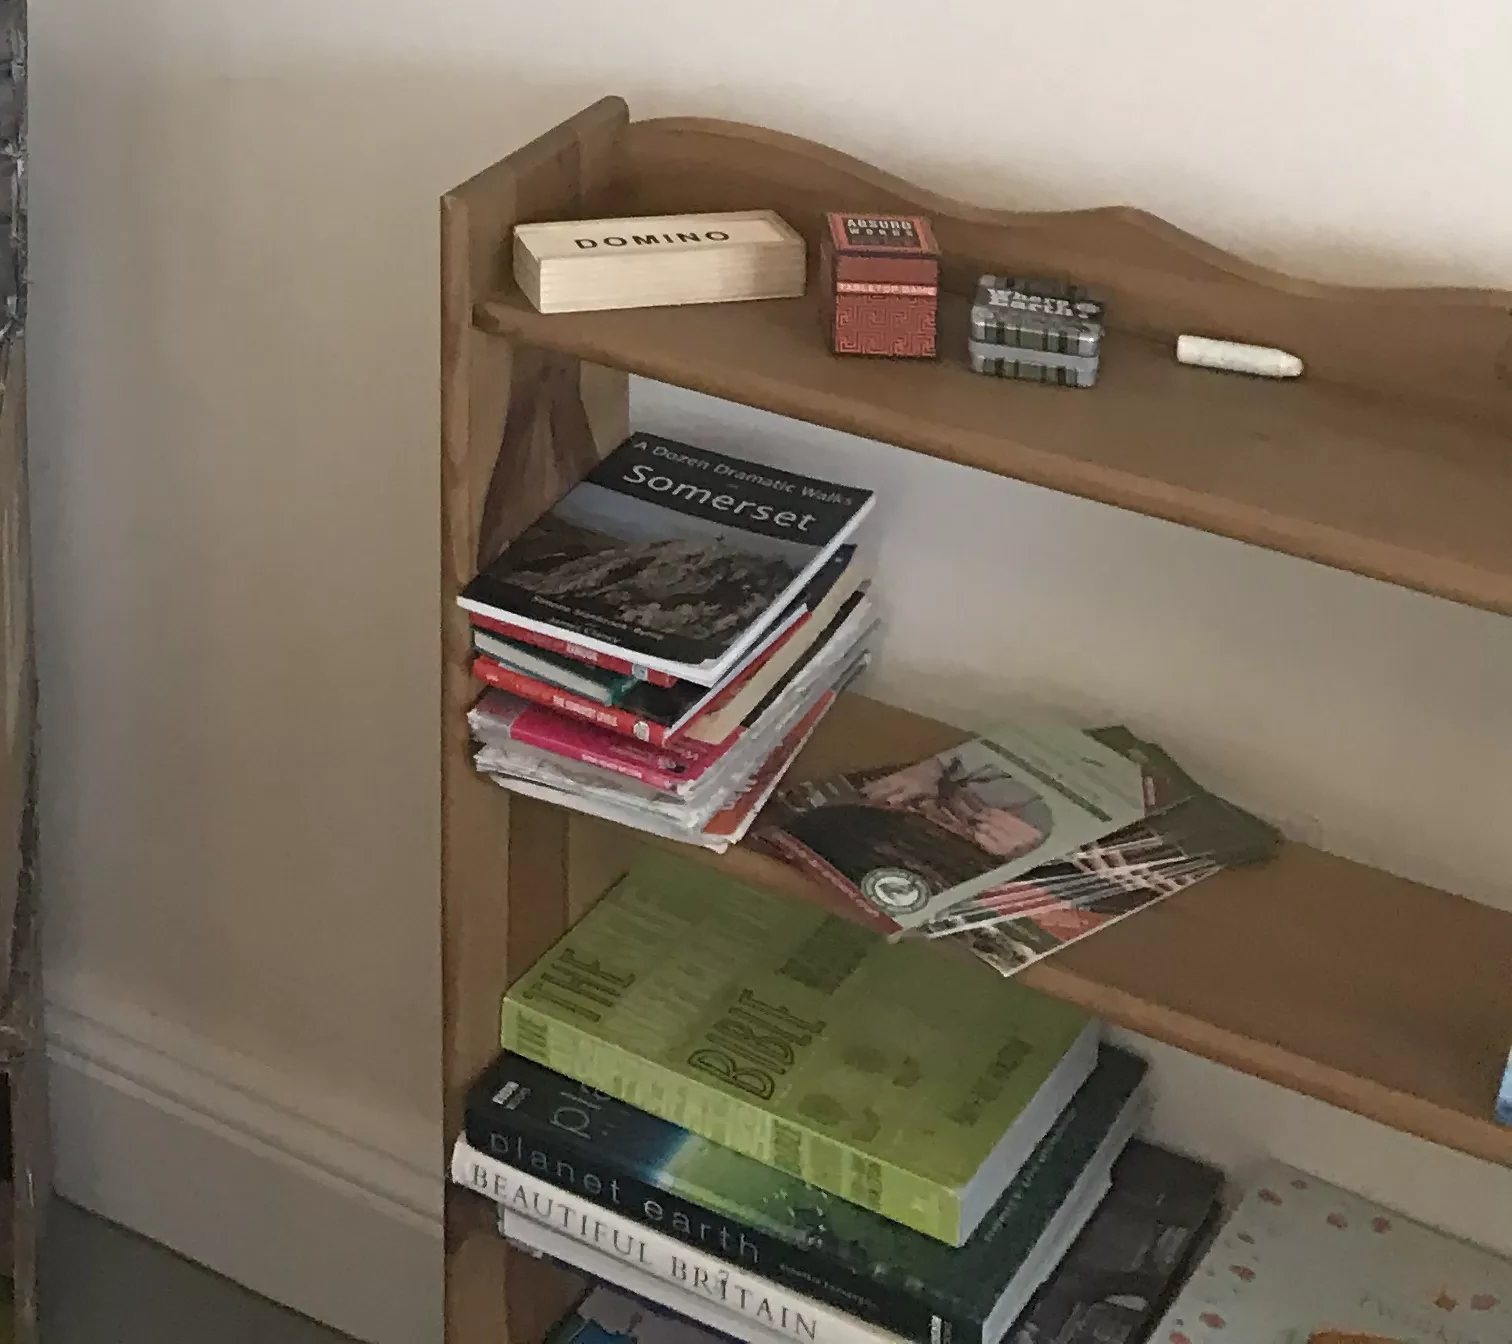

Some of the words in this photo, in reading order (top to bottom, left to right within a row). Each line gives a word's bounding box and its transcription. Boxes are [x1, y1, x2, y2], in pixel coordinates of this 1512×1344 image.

[574, 230, 730, 250] DOMINO
[621, 464, 816, 532] Somerset
[633, 440, 649, 451] A
[652, 445, 710, 471] Dozen
[713, 462, 796, 494] Dramatic
[801, 485, 853, 507] Walks
[522, 947, 637, 1023] THE
[687, 988, 827, 1102] BIBLE
[489, 1130, 621, 1206] planet
[642, 1198, 760, 1264] earth
[471, 1162, 649, 1265] BEAUTIFUL
[670, 1254, 819, 1341] BRITAIN
